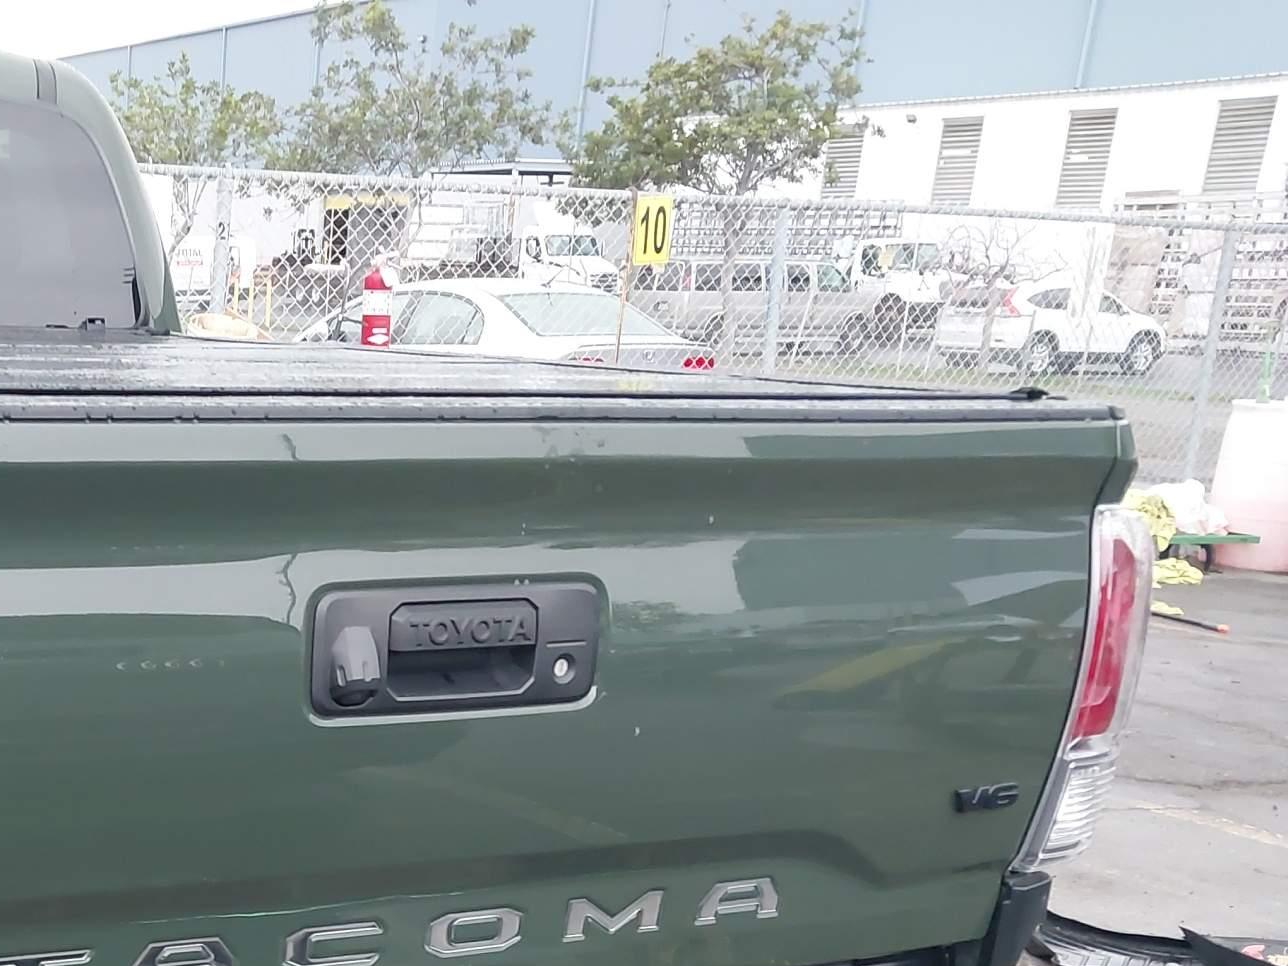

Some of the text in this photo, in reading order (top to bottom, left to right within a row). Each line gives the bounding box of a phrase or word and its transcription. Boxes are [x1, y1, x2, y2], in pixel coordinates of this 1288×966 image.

[640, 206, 667, 254] 10
[409, 615, 532, 647] TOYOTA
[953, 782, 1019, 813] V6
